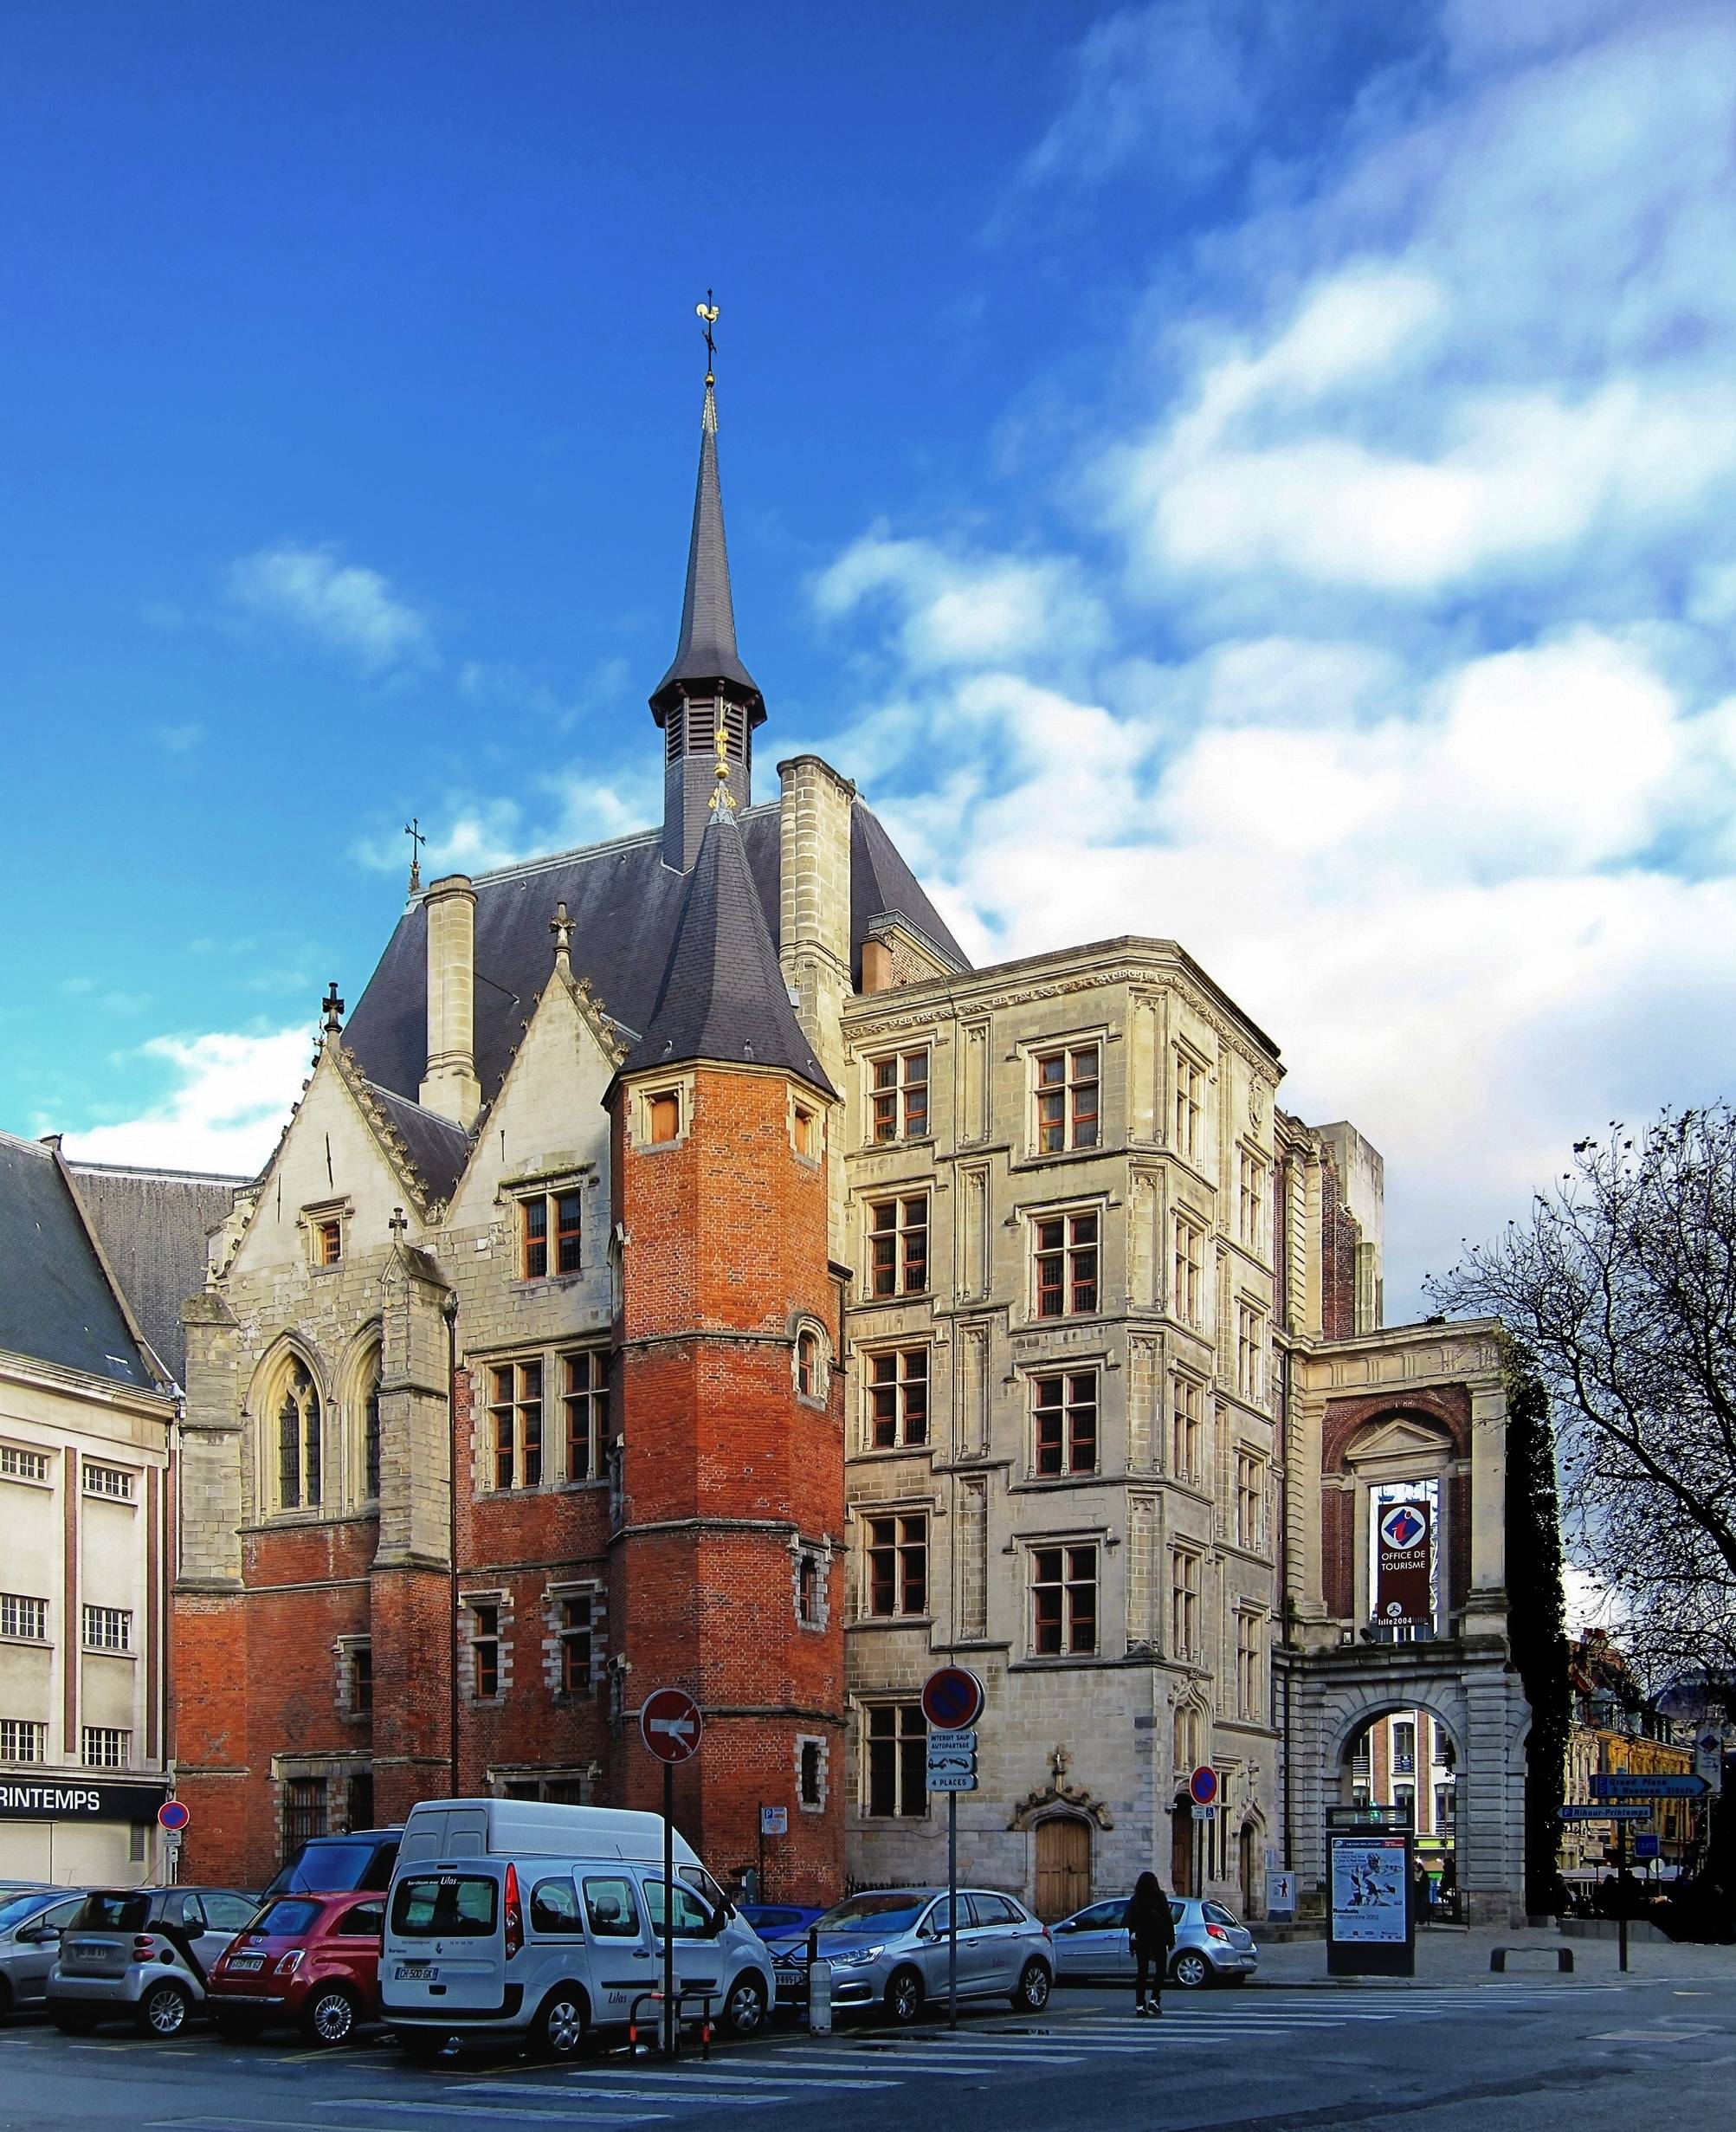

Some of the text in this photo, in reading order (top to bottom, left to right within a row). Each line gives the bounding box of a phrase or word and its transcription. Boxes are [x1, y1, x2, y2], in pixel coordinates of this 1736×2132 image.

[1381, 1550, 1426, 1560] OFFICE DE
[1381, 1560, 1426, 1571] TOURISME
[1573, 1807, 1649, 1819] Rihour-Printemps
[440, 1876, 457, 1885] Lilas
[608, 1991, 628, 2004] Lilas
